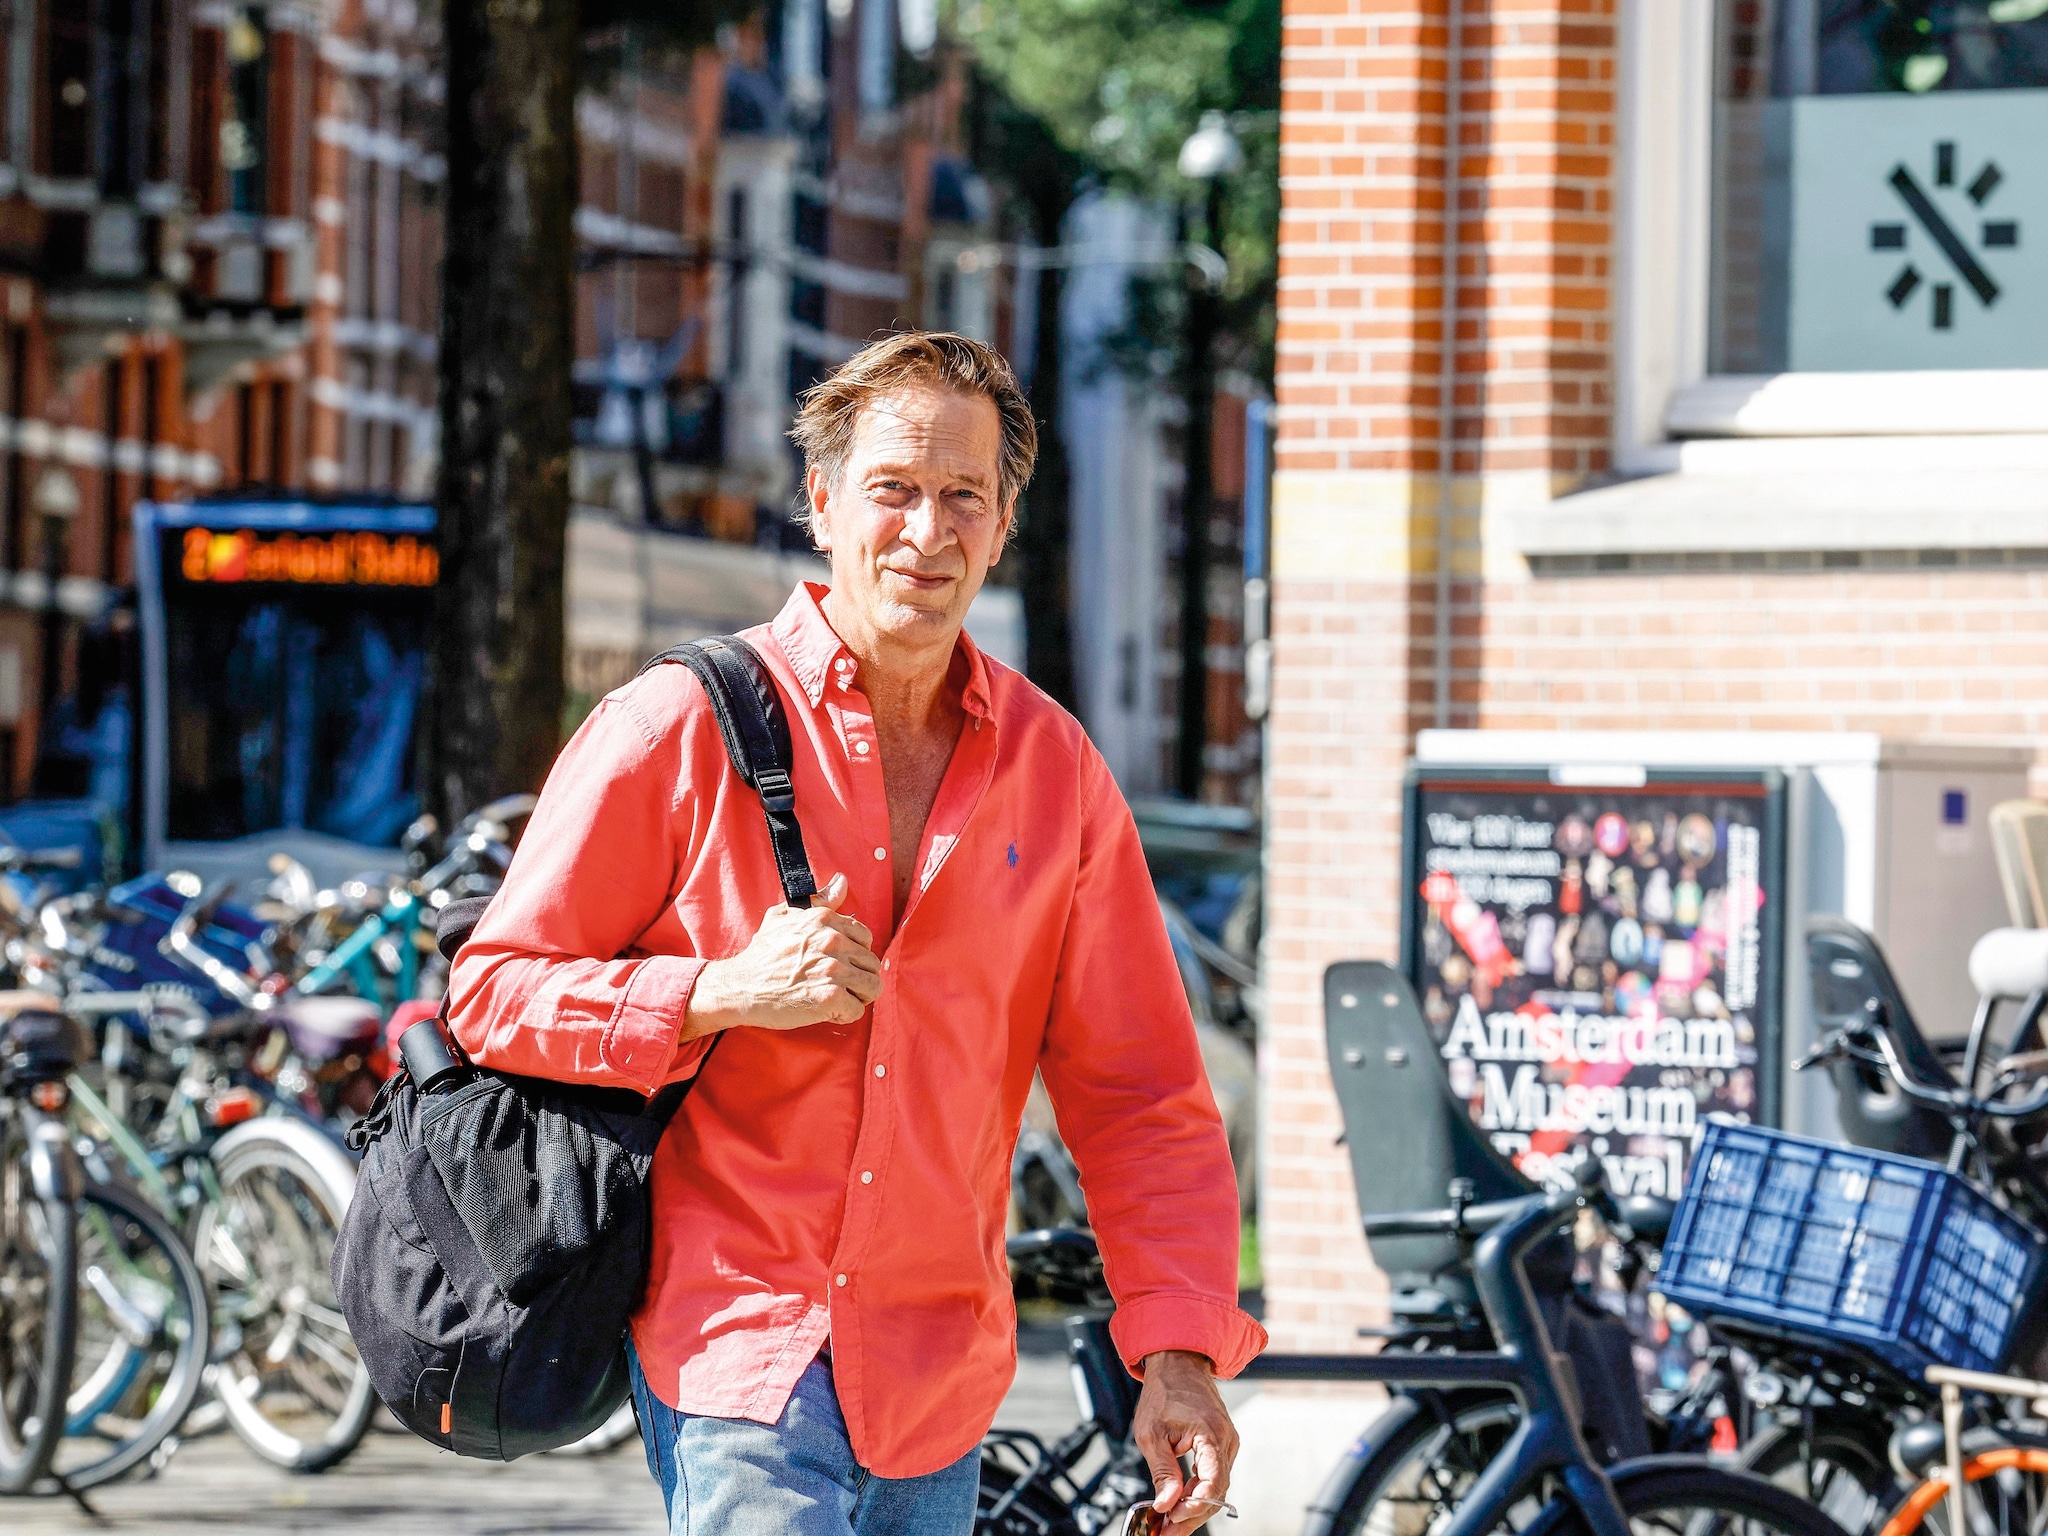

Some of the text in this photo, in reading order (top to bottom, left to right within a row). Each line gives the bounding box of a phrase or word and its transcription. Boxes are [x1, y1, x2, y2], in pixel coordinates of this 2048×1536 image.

[1441, 993, 1739, 1068] Amsterdam
[1479, 1063, 1696, 1137] Museum
[1489, 1131, 1683, 1201] esval
